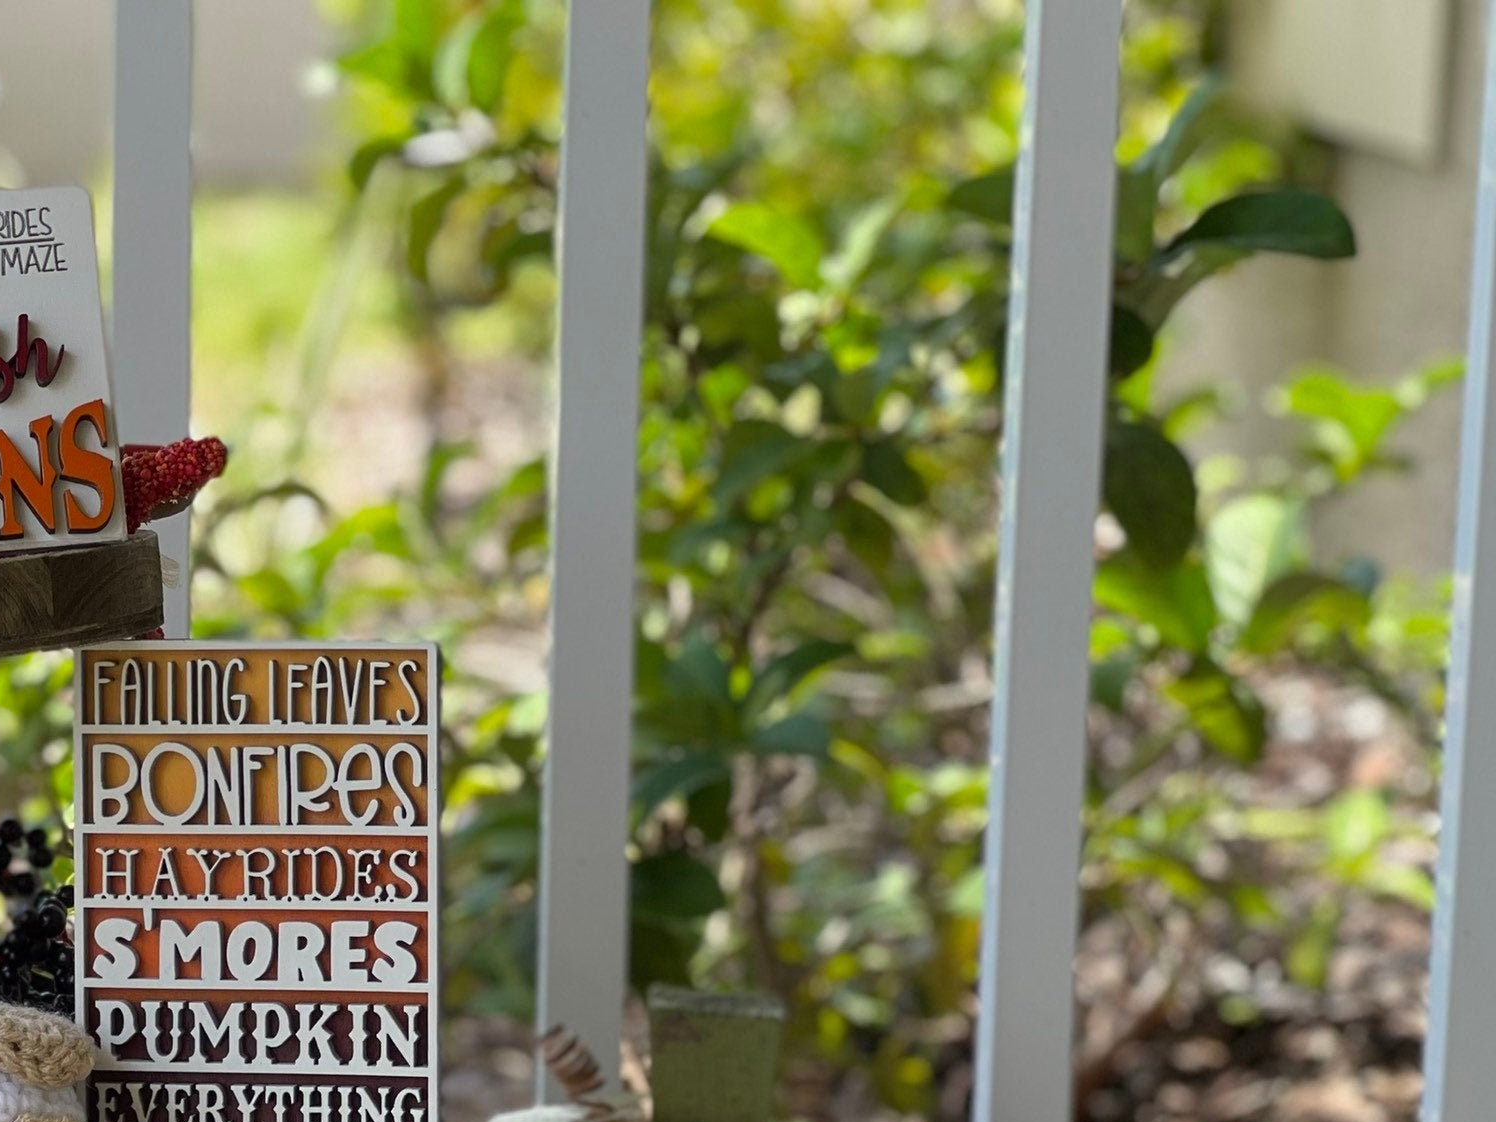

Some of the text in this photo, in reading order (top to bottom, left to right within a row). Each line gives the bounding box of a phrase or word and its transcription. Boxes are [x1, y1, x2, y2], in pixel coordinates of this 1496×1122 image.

[0, 243, 68, 276] MAZE
[93, 656, 421, 726] FALLING LEAVES
[94, 846, 420, 903] HAYRIDES
[92, 905, 420, 983] S'MORES
[94, 1000, 422, 1067] PUMPKIN
